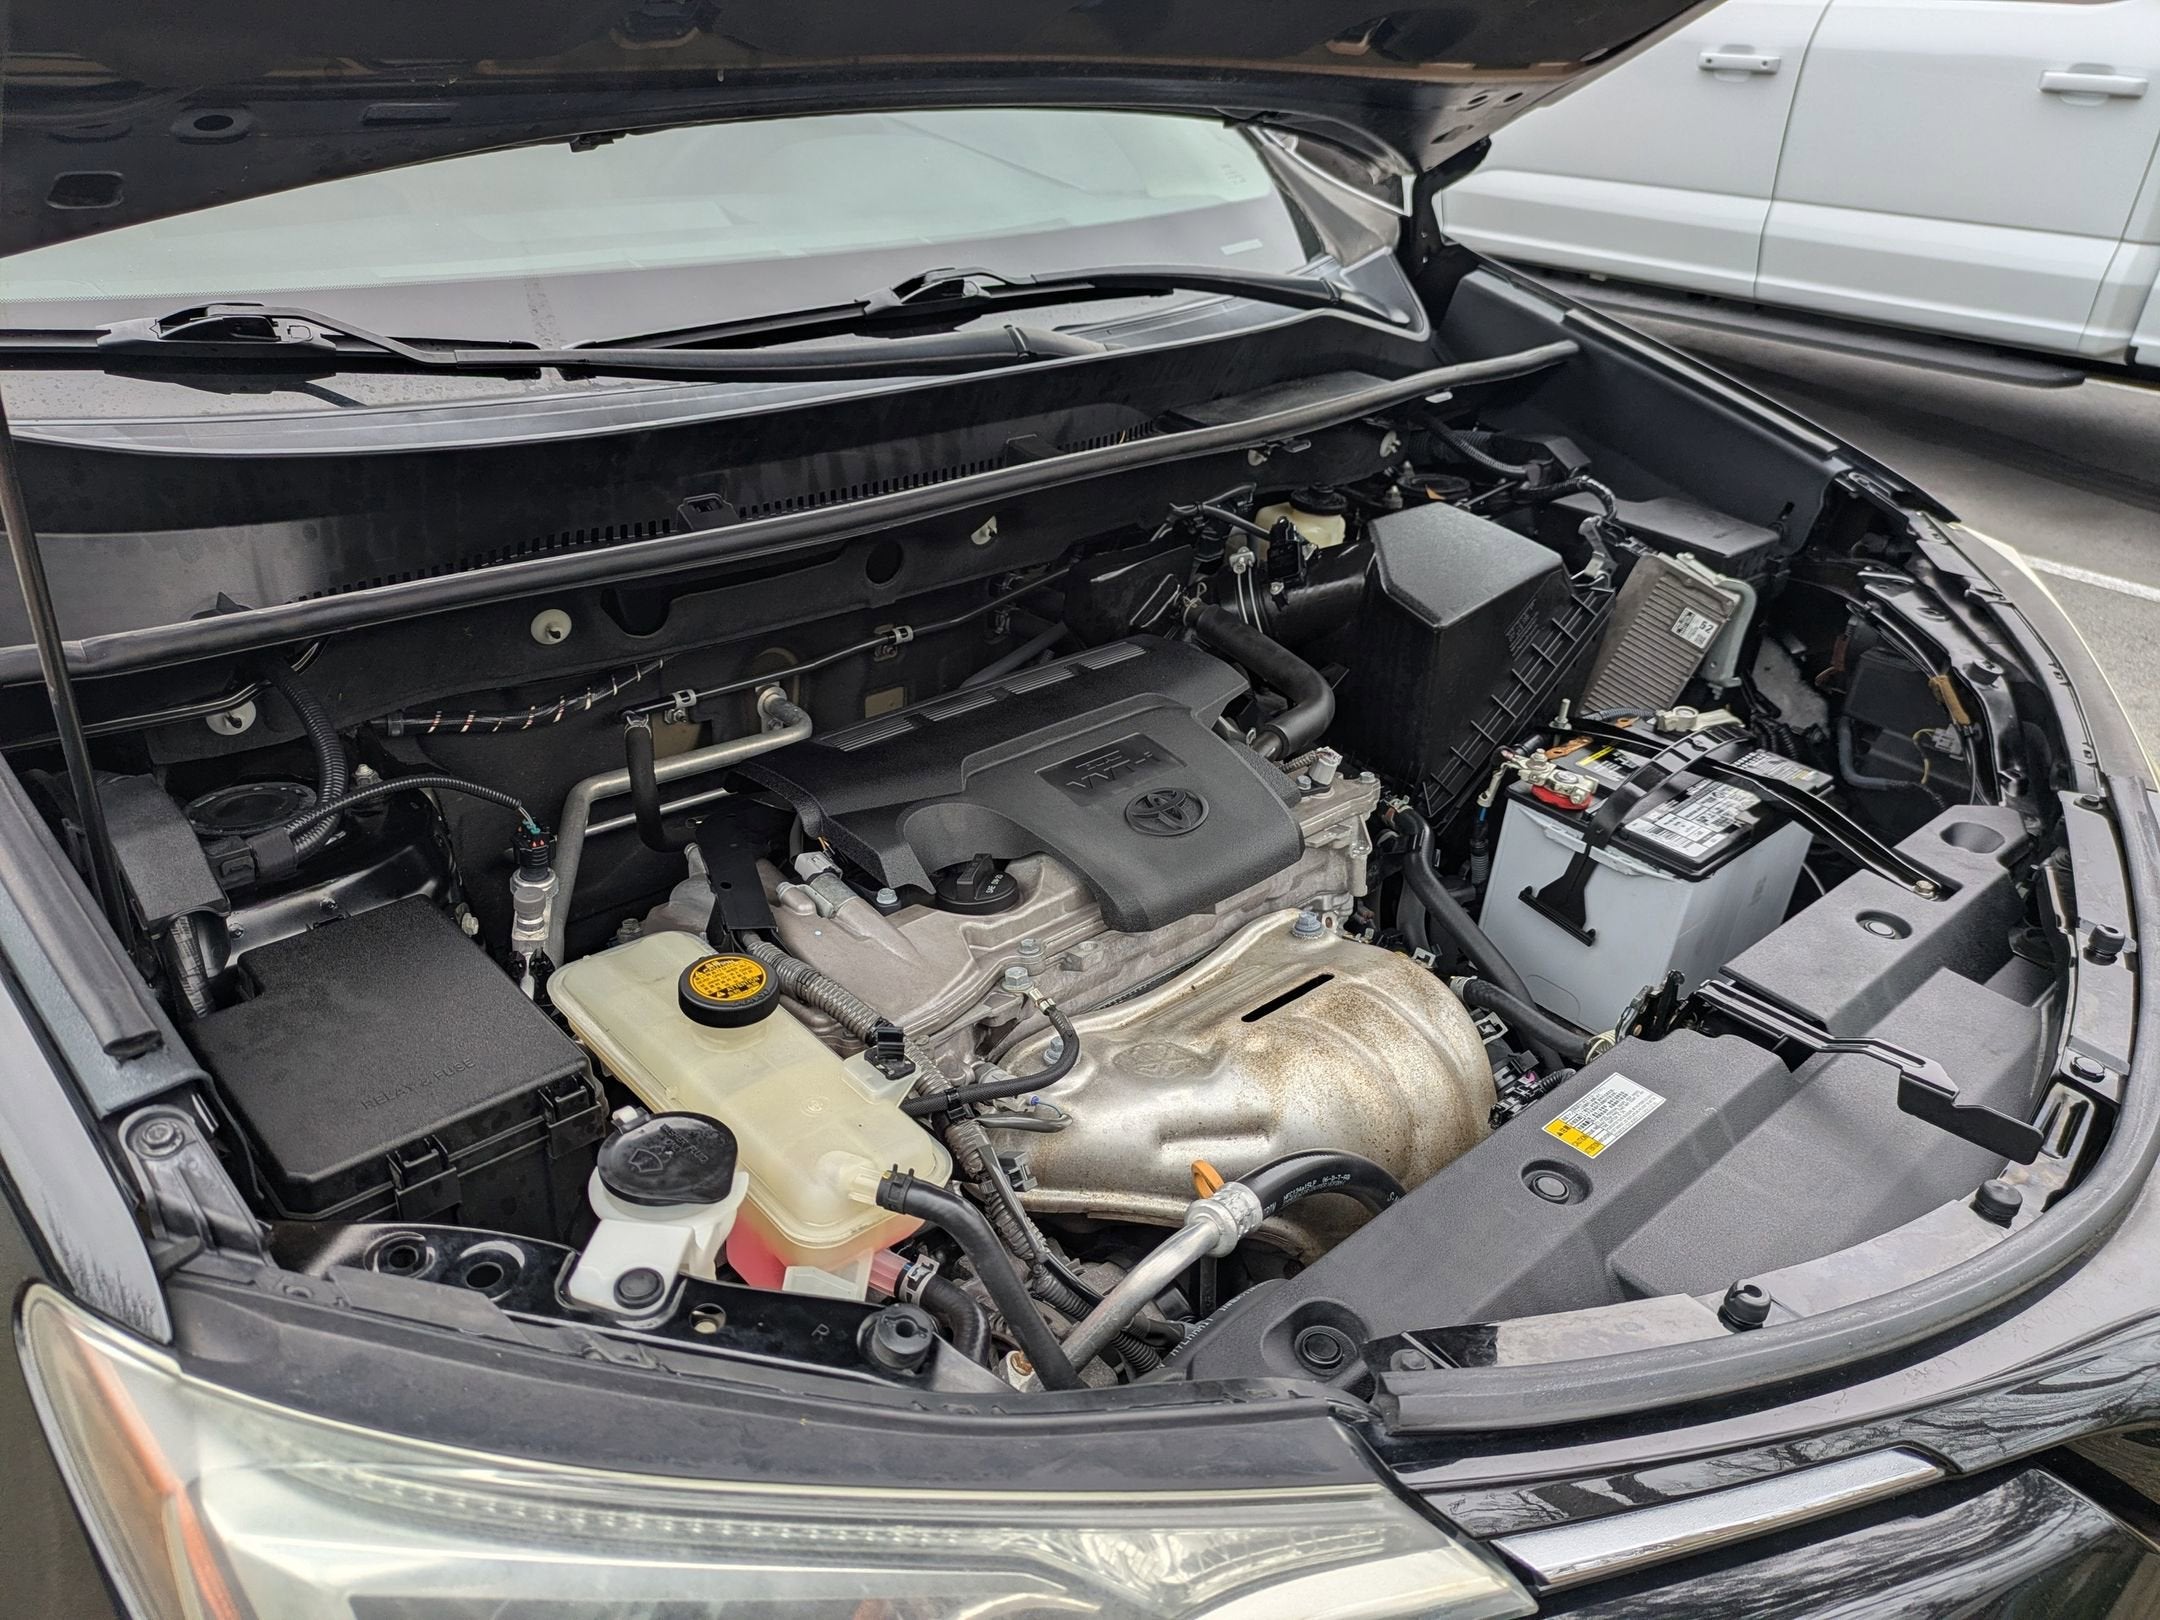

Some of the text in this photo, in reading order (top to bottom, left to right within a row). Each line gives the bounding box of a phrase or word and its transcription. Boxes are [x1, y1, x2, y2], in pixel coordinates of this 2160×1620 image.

[1699, 620, 1714, 634] 52
[360, 1057, 476, 1111] RELAY & FUSE
